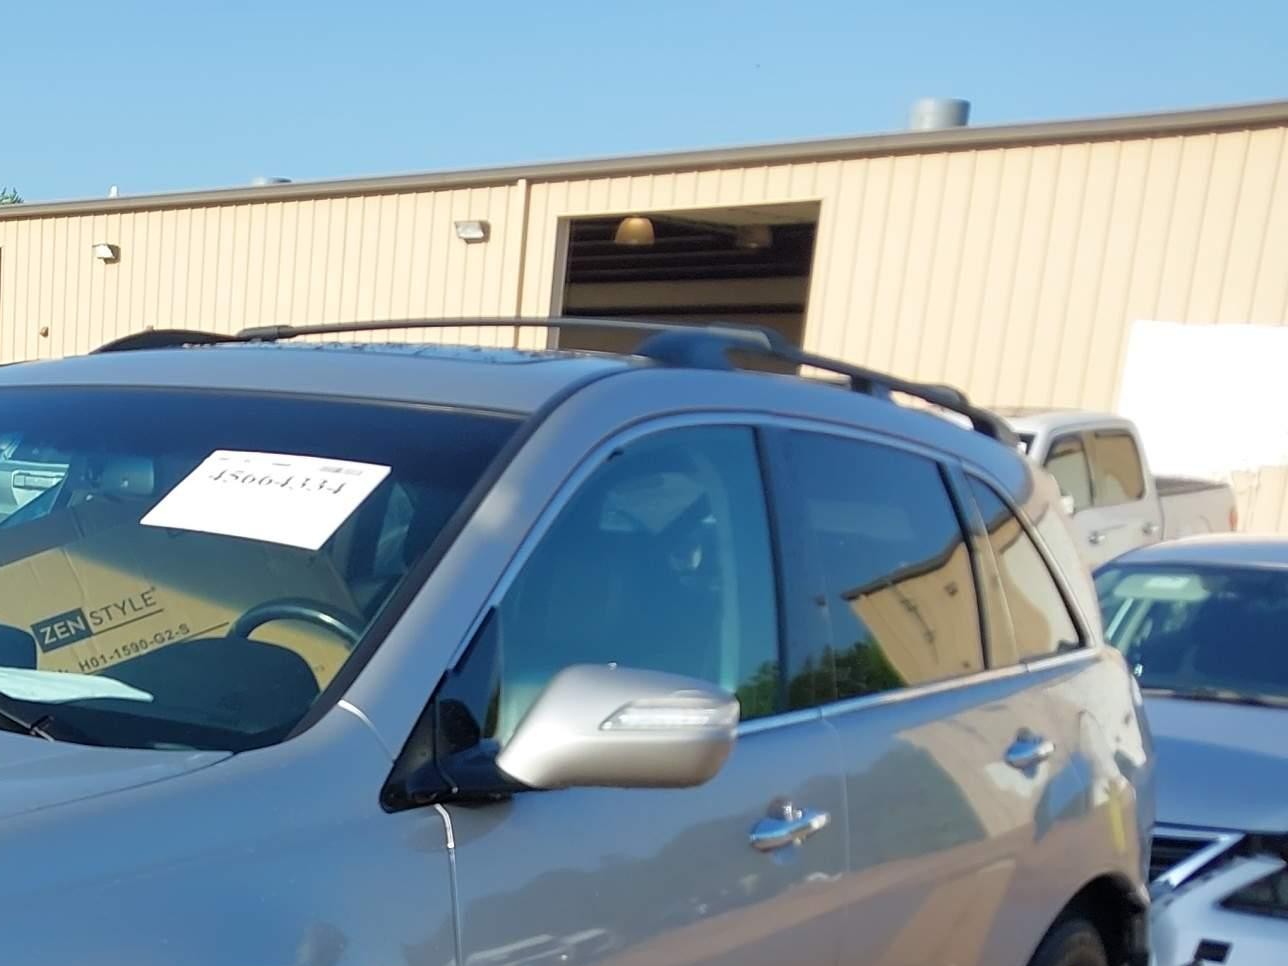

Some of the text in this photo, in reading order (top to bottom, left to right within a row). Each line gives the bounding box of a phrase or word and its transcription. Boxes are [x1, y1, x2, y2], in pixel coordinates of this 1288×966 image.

[208, 468, 347, 495] 45664334
[39, 616, 87, 645] ZEN
[78, 623, 190, 672] H01-1590-G2-S
